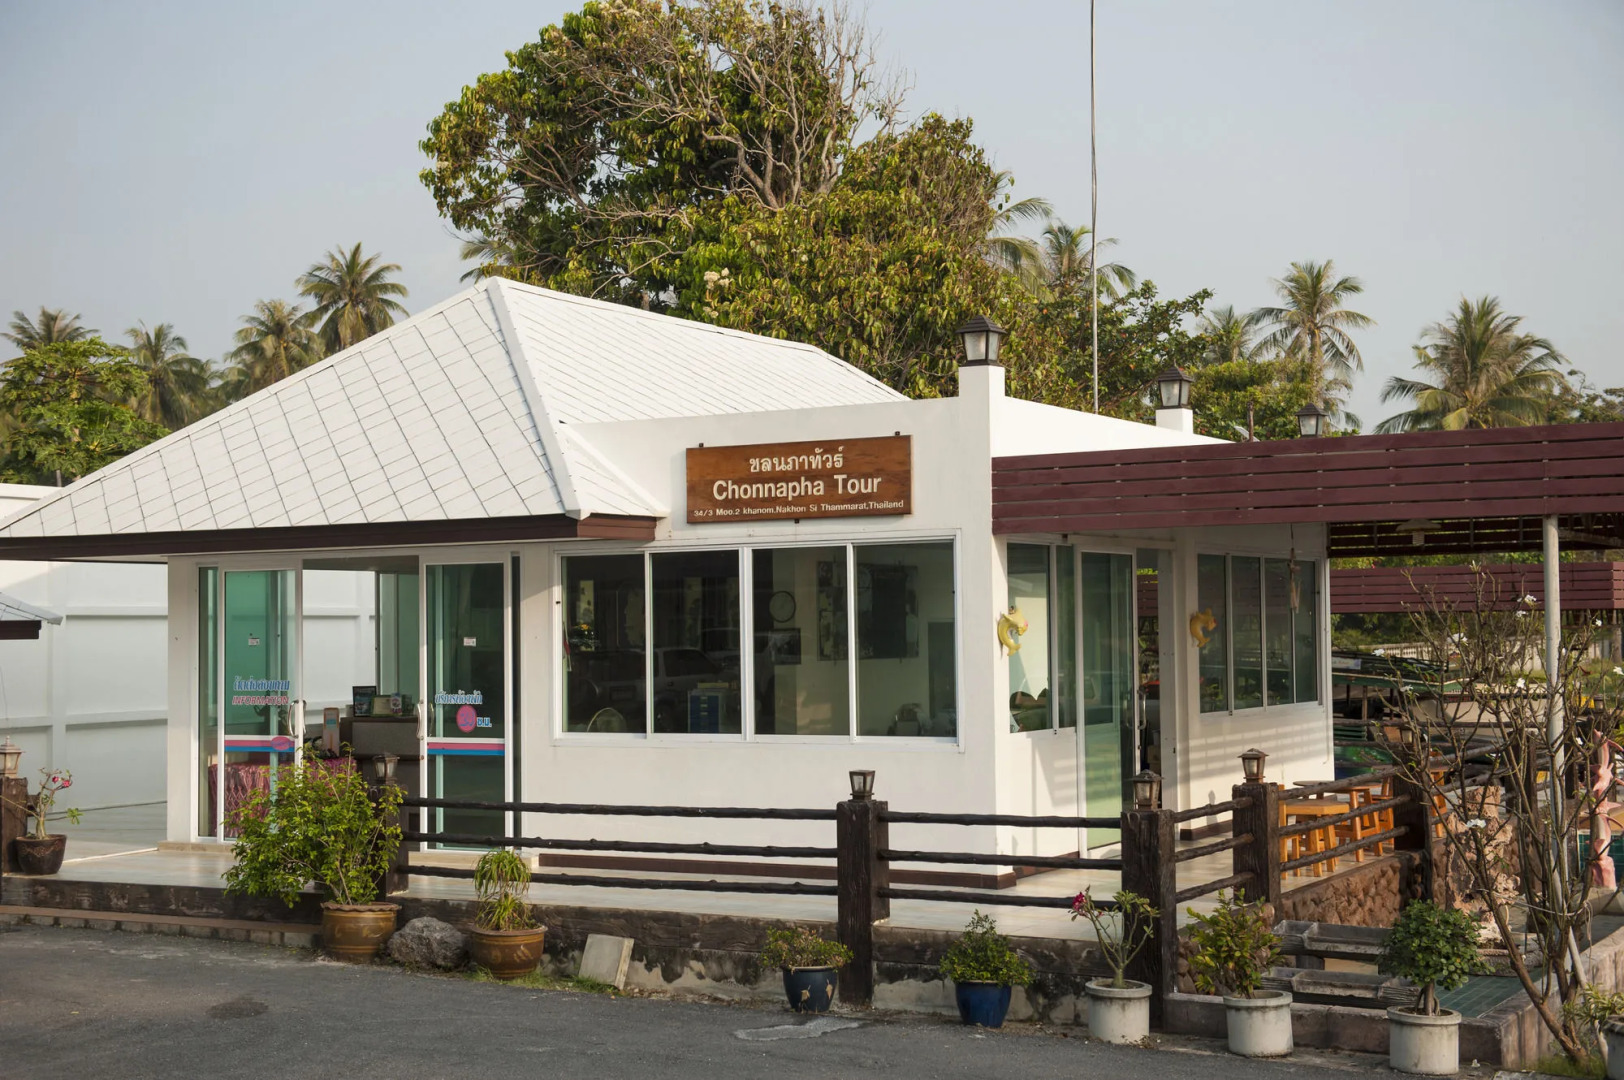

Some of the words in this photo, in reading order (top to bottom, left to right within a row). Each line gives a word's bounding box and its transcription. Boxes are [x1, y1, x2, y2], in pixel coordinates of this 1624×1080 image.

[749, 446, 844, 473] ชลนภาทัวร์
[712, 476, 825, 501] Chonnapha
[833, 474, 882, 495] Tour
[693, 509, 714, 518] 34/3
[809, 503, 818, 513] Si
[232, 696, 290, 705] INFORMATION
